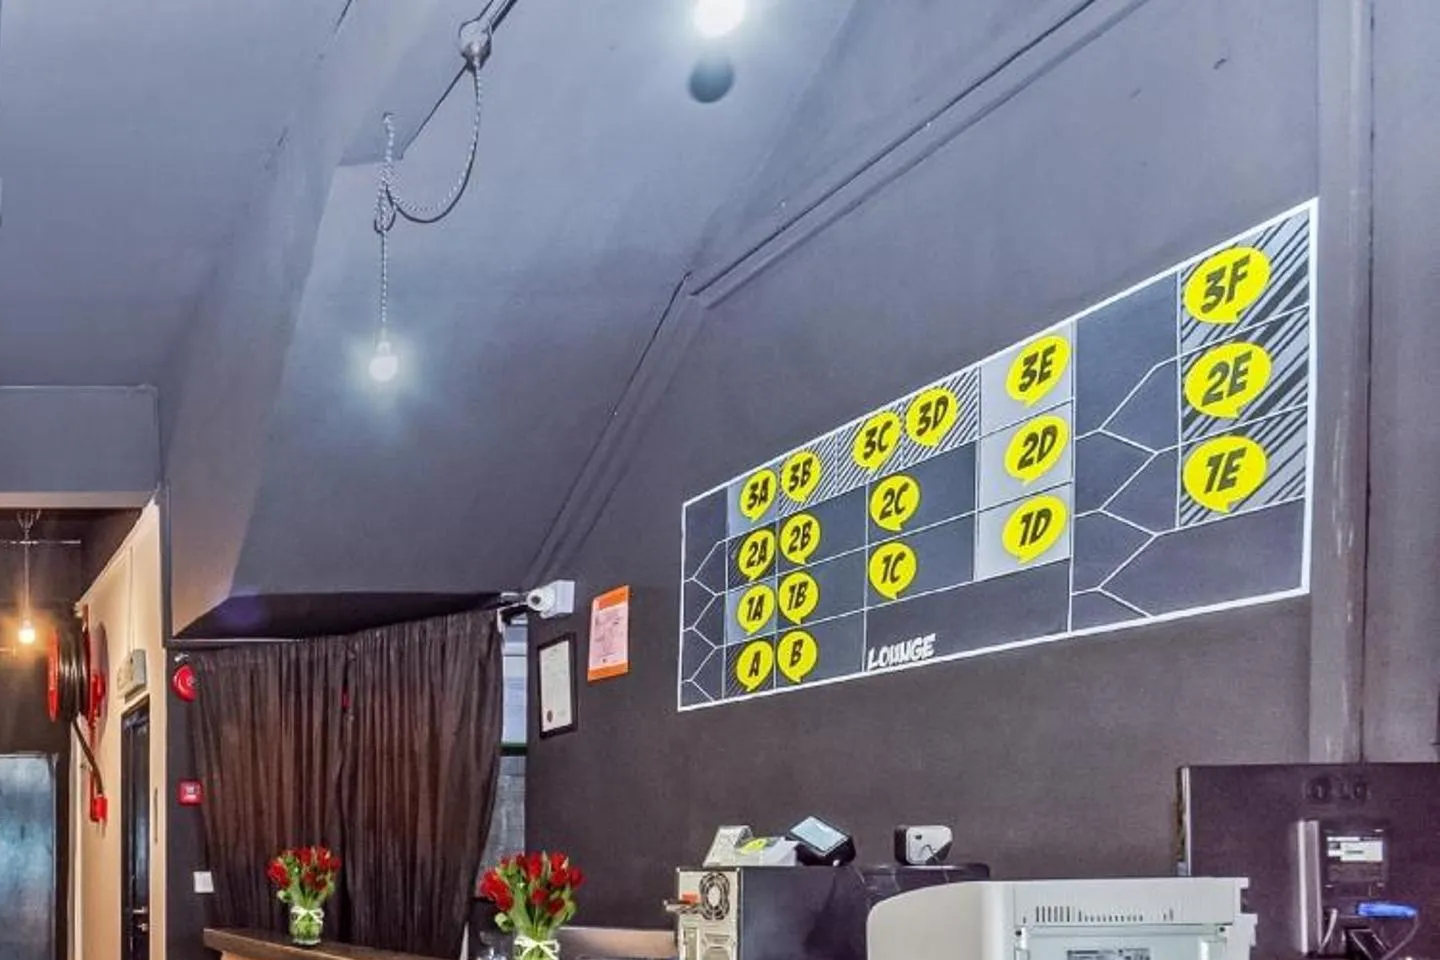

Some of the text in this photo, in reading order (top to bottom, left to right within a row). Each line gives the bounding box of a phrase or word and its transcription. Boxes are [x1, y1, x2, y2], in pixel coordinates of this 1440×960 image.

[1201, 254, 1251, 314] 3F
[1018, 344, 1056, 393] 3E
[1201, 351, 1253, 407] 2E
[916, 395, 948, 436] 3D
[863, 420, 892, 460] 3C
[1017, 424, 1058, 471] 2D
[788, 457, 813, 492] 3B
[1204, 447, 1247, 494] 1E
[746, 477, 769, 511] 3A
[879, 482, 910, 520] 2C
[788, 522, 811, 553] 2B
[1019, 508, 1052, 547] 1D
[746, 536, 768, 569] 2A
[881, 551, 906, 584] 1C
[746, 595, 765, 622] 1A
[788, 580, 810, 610] 1B
[748, 651, 760, 678] A
[790, 639, 802, 667] B
[867, 634, 936, 668] LOUNGE
